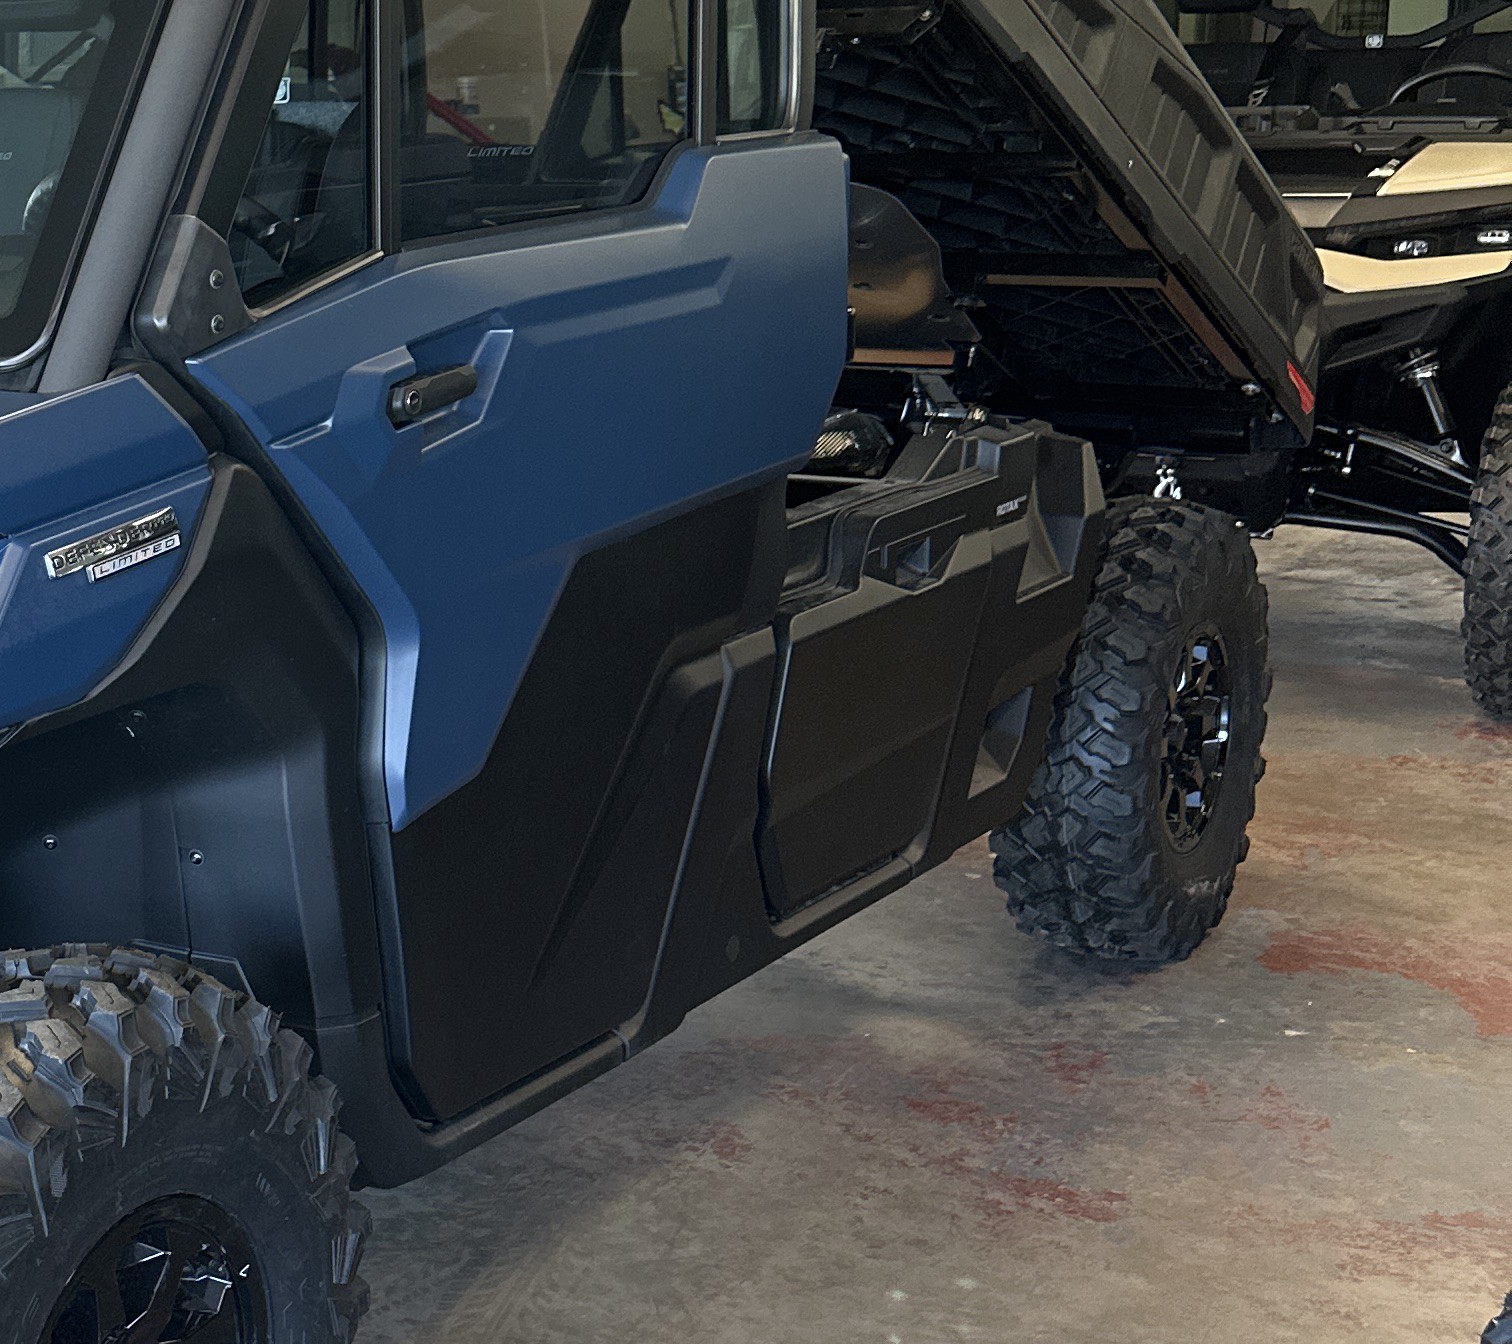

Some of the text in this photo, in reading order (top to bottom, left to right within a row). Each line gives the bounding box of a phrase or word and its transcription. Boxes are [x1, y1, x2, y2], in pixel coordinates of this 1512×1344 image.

[467, 145, 535, 157] LIMITED
[52, 523, 154, 571] DEFENDER
[99, 538, 176, 575] LIMITED
